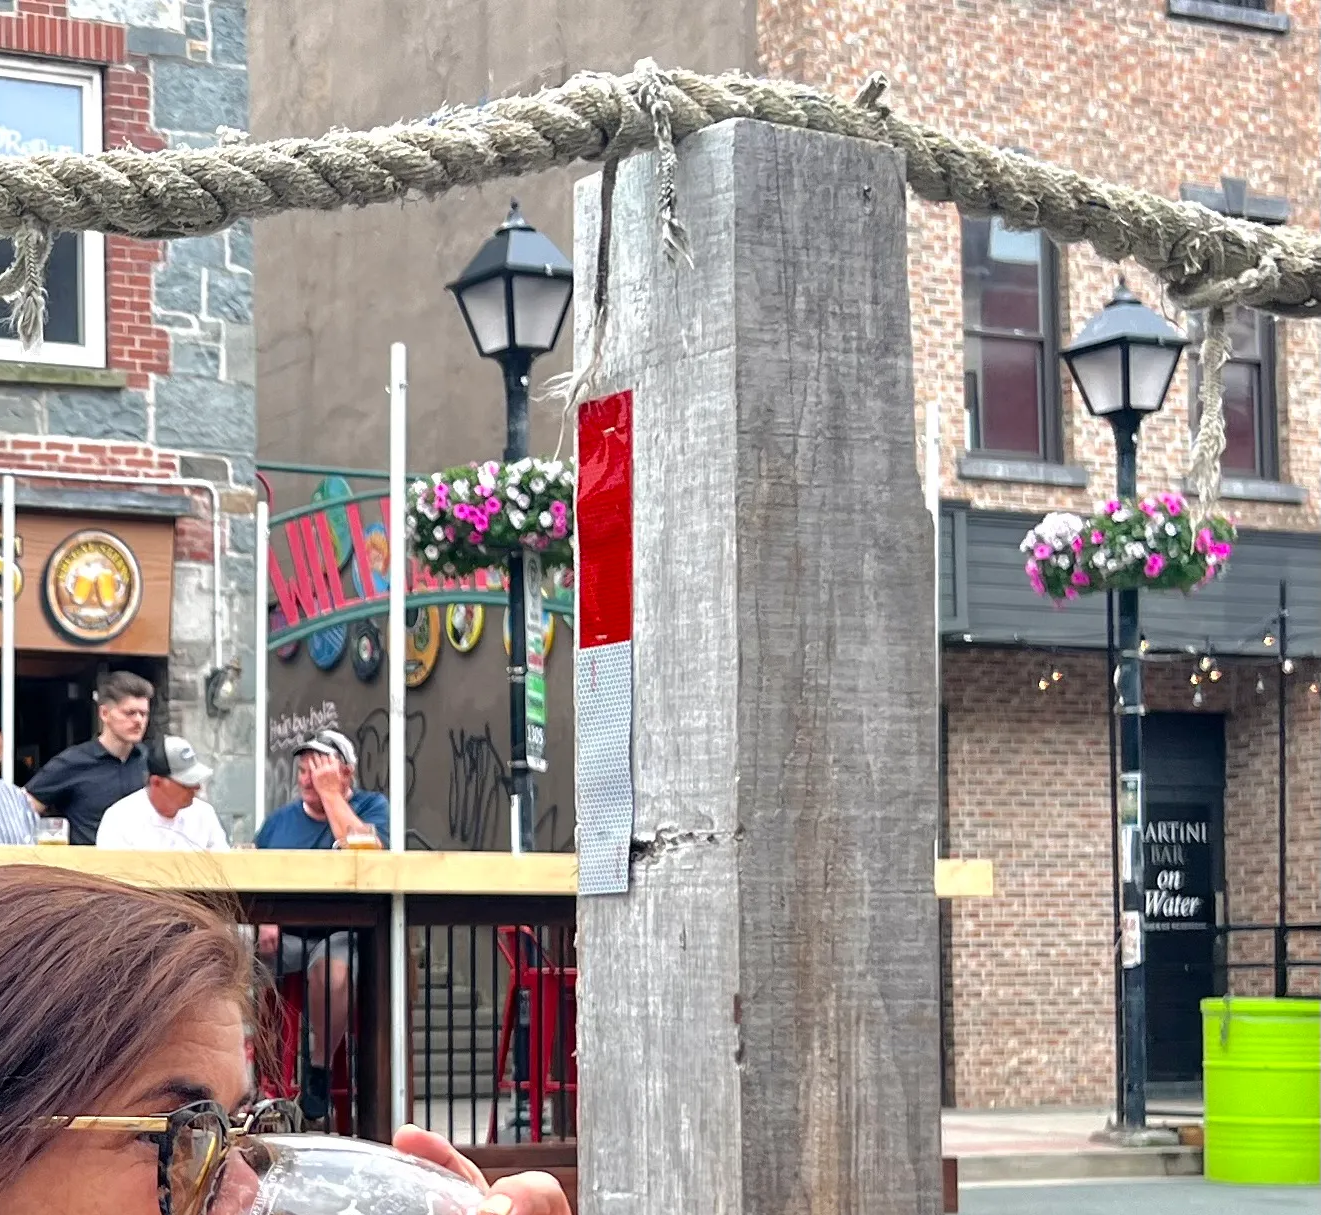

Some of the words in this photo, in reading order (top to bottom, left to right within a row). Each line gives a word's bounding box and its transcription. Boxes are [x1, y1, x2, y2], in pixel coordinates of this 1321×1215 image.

[1142, 821, 1208, 843] ARTINI
[1151, 844, 1185, 865] BAR
[1157, 870, 1185, 889] on
[1145, 889, 1203, 917] Water
